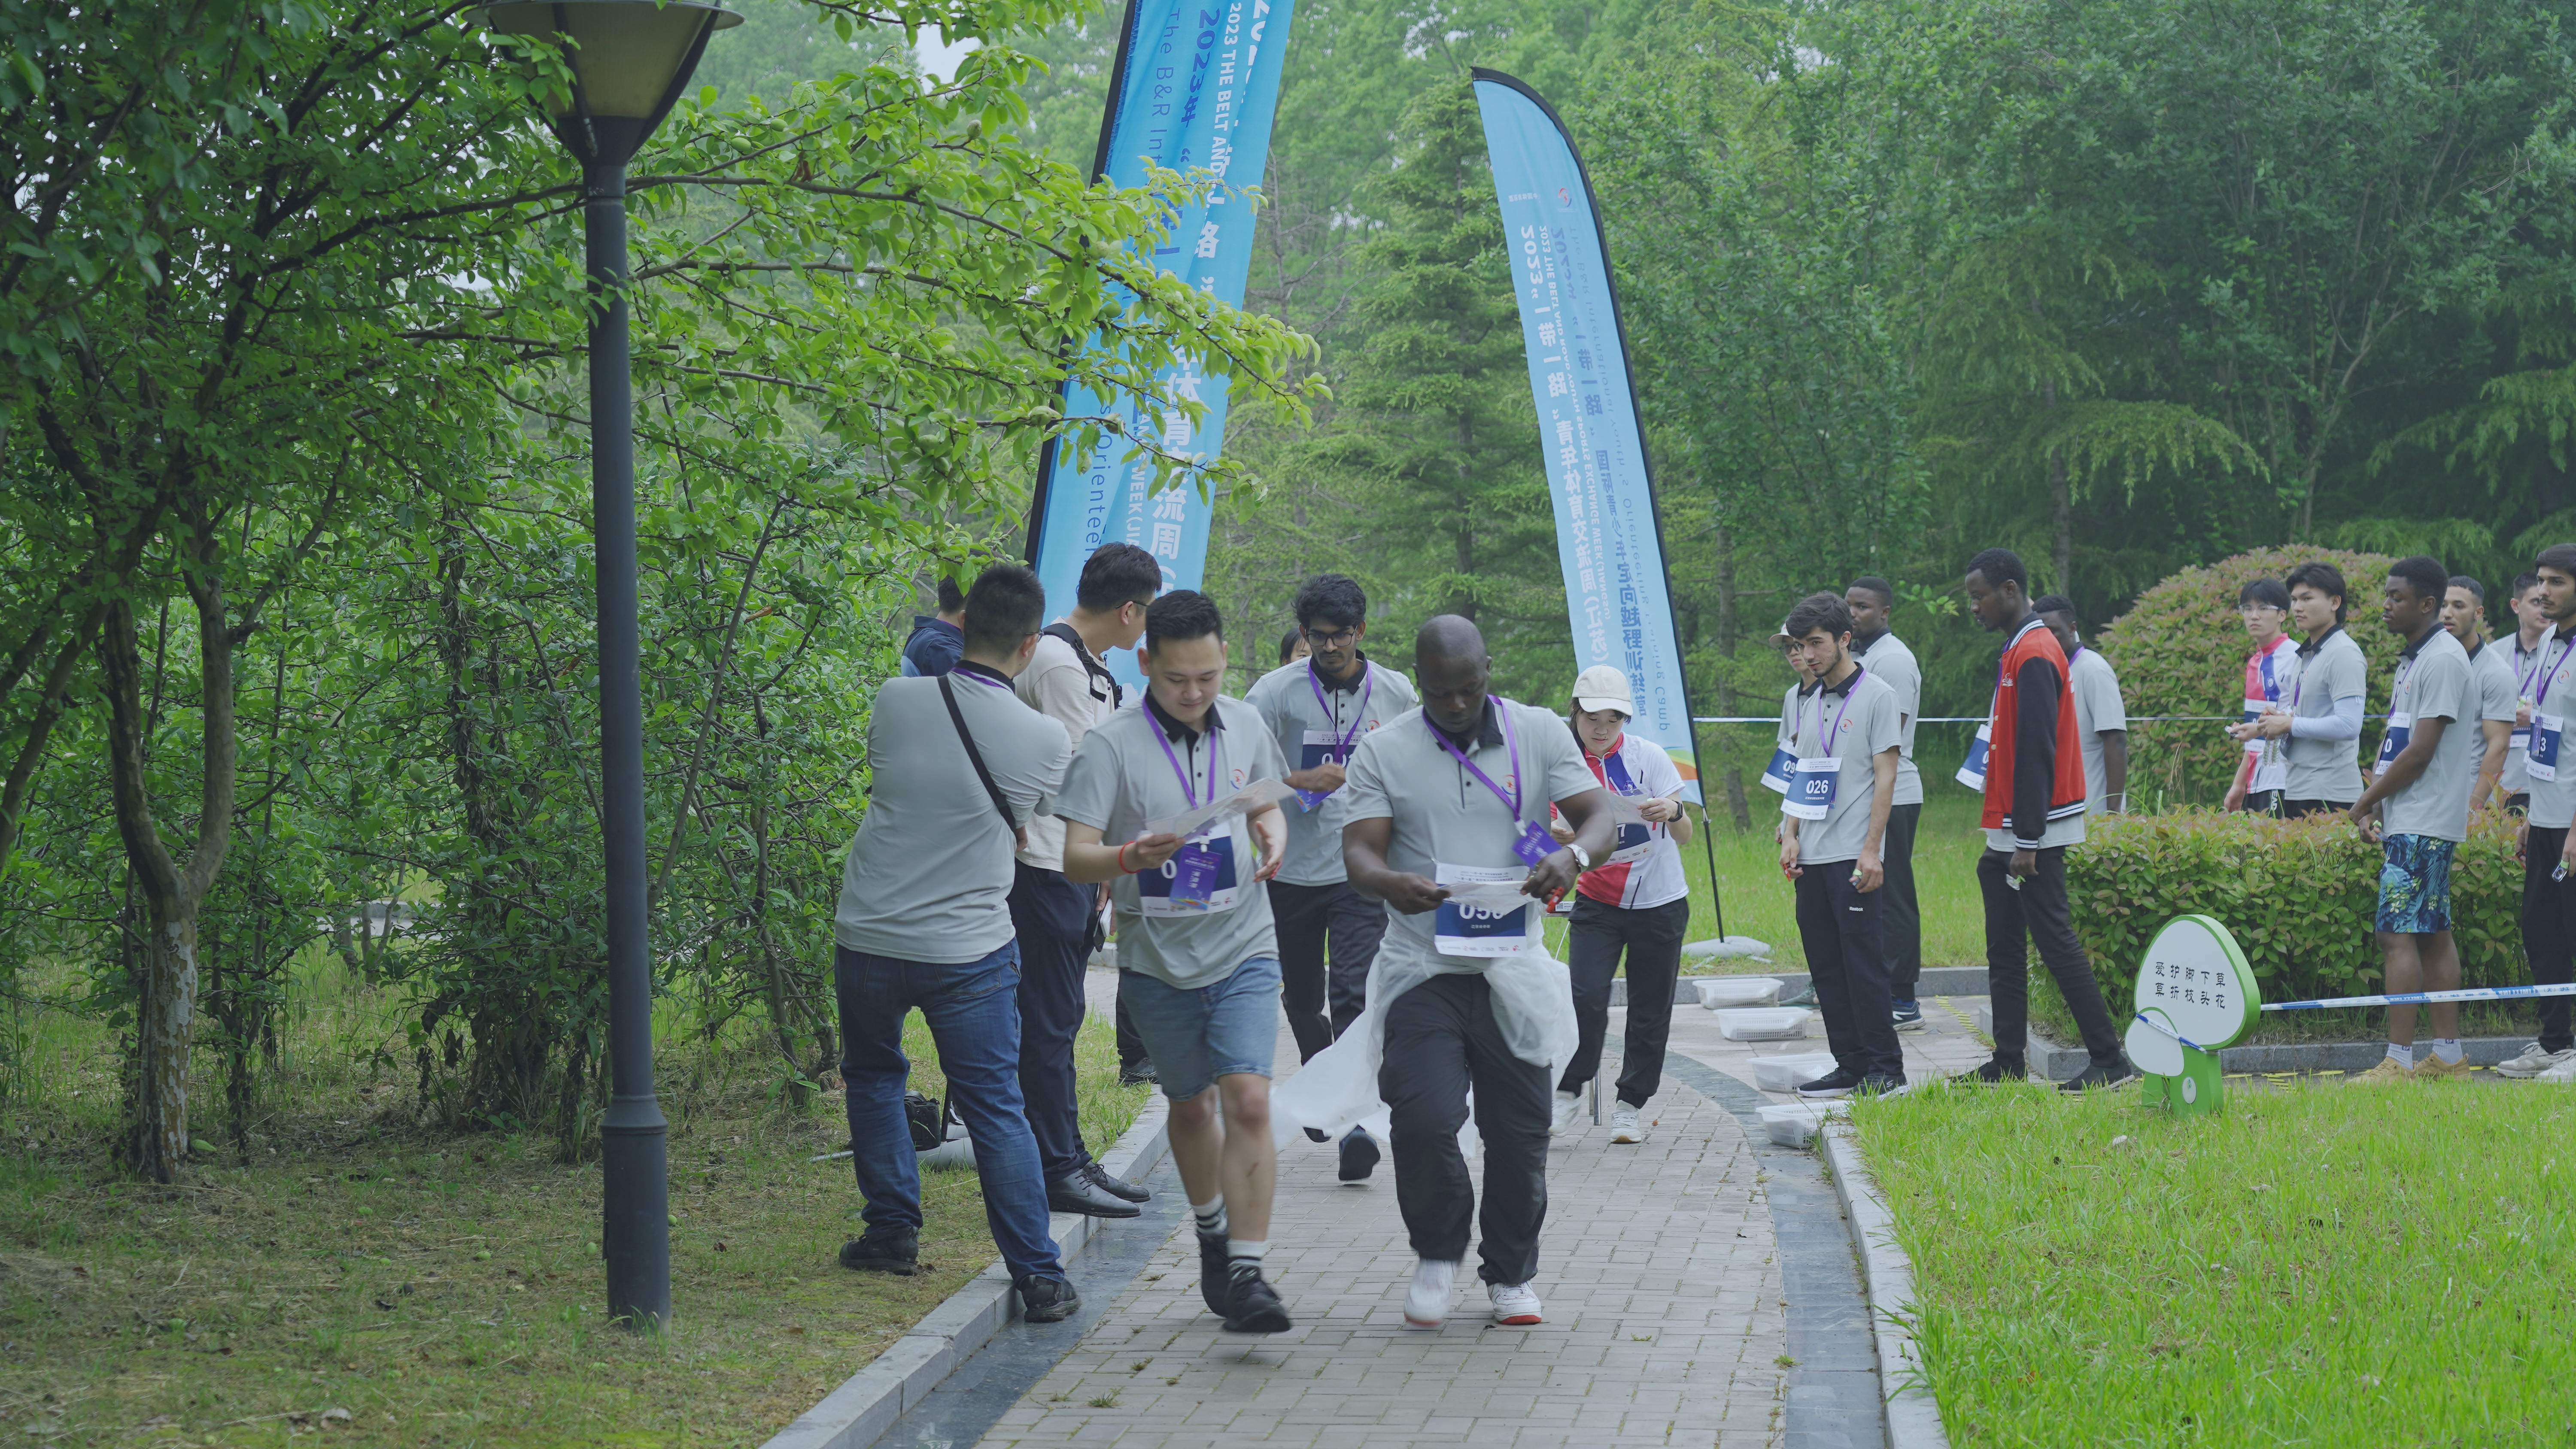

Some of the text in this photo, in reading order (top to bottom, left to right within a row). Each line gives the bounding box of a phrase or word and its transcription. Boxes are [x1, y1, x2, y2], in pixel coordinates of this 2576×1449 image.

[1160, 7, 1180, 54] The
[1224, 2, 1242, 45] 2023
[1219, 49, 1236, 86] THE
[1152, 67, 1174, 116] B&R
[1214, 90, 1232, 131] BELT
[1210, 136, 1227, 173] AND
[1126, 467, 1145, 546] WEEK(JIA
[1783, 760, 1798, 774] 09
[1805, 779, 1829, 794] 026
[2155, 962, 2226, 988] 爱护脚下草
[2154, 982, 2226, 1009] 莫折枝头花
